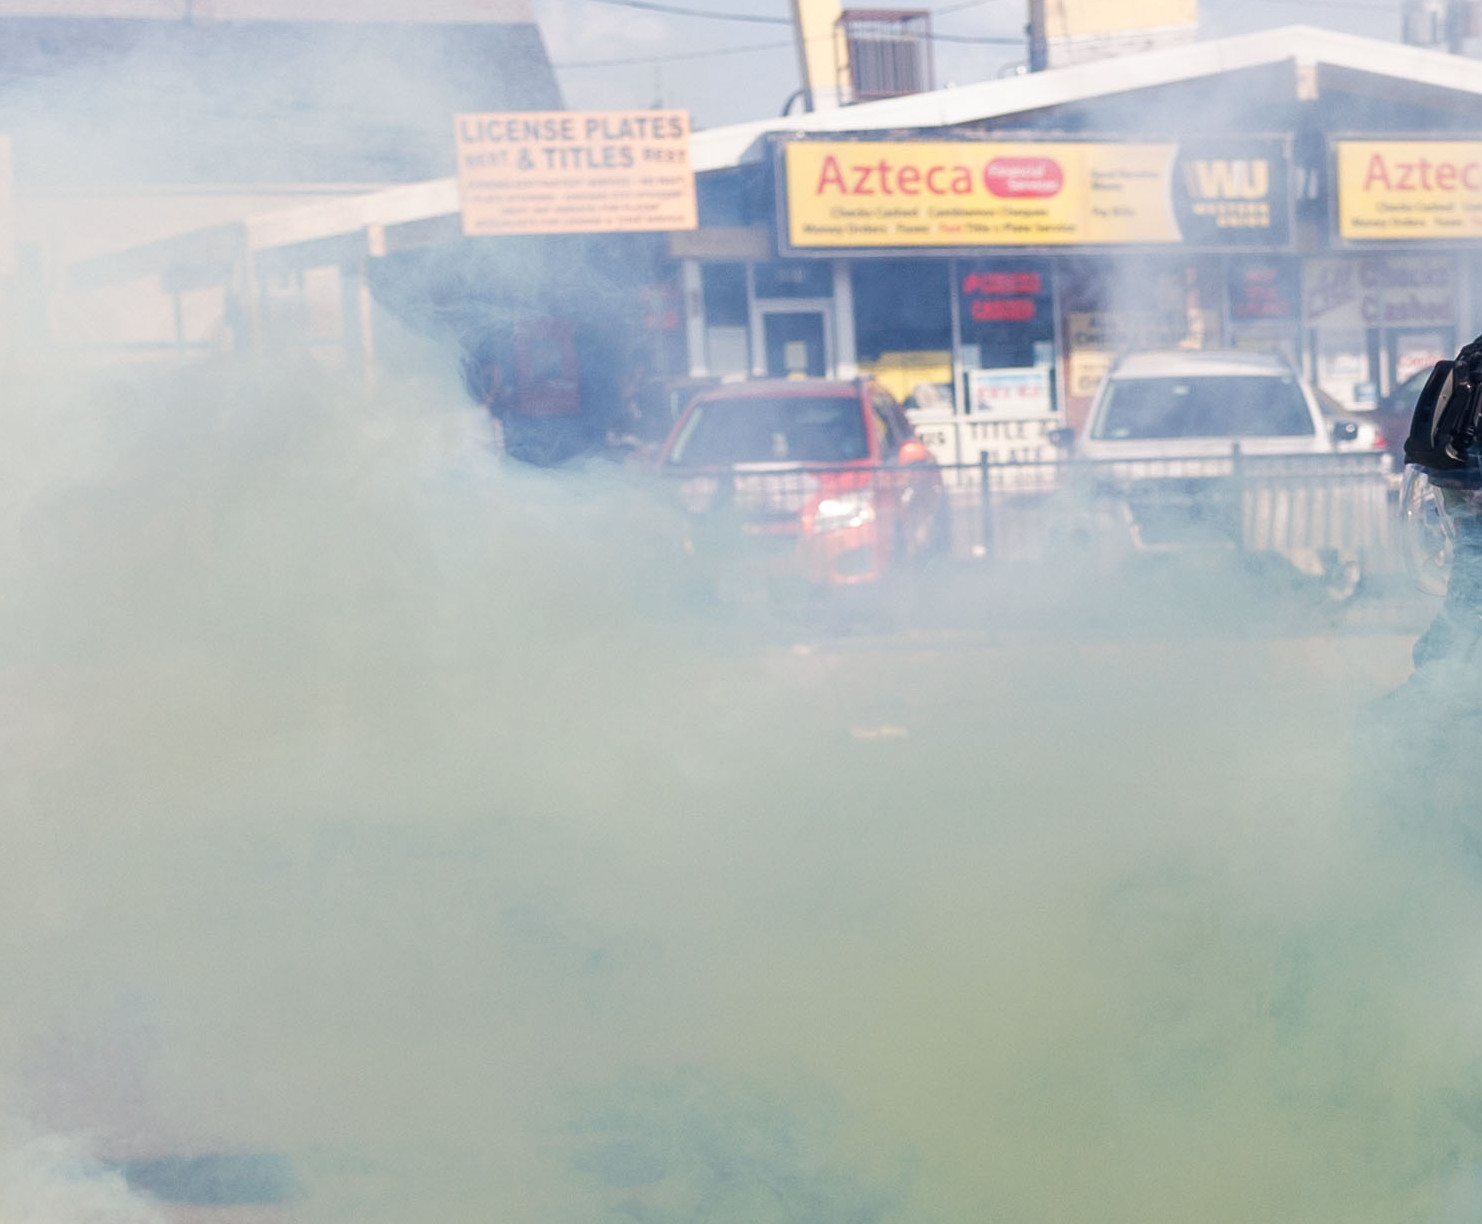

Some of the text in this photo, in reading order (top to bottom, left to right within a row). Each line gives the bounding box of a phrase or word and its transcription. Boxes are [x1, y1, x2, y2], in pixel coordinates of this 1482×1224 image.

[461, 115, 685, 143] LICENSE PLATES
[517, 147, 536, 170] &
[543, 145, 635, 169] TITLES
[815, 153, 975, 197] Azteca
